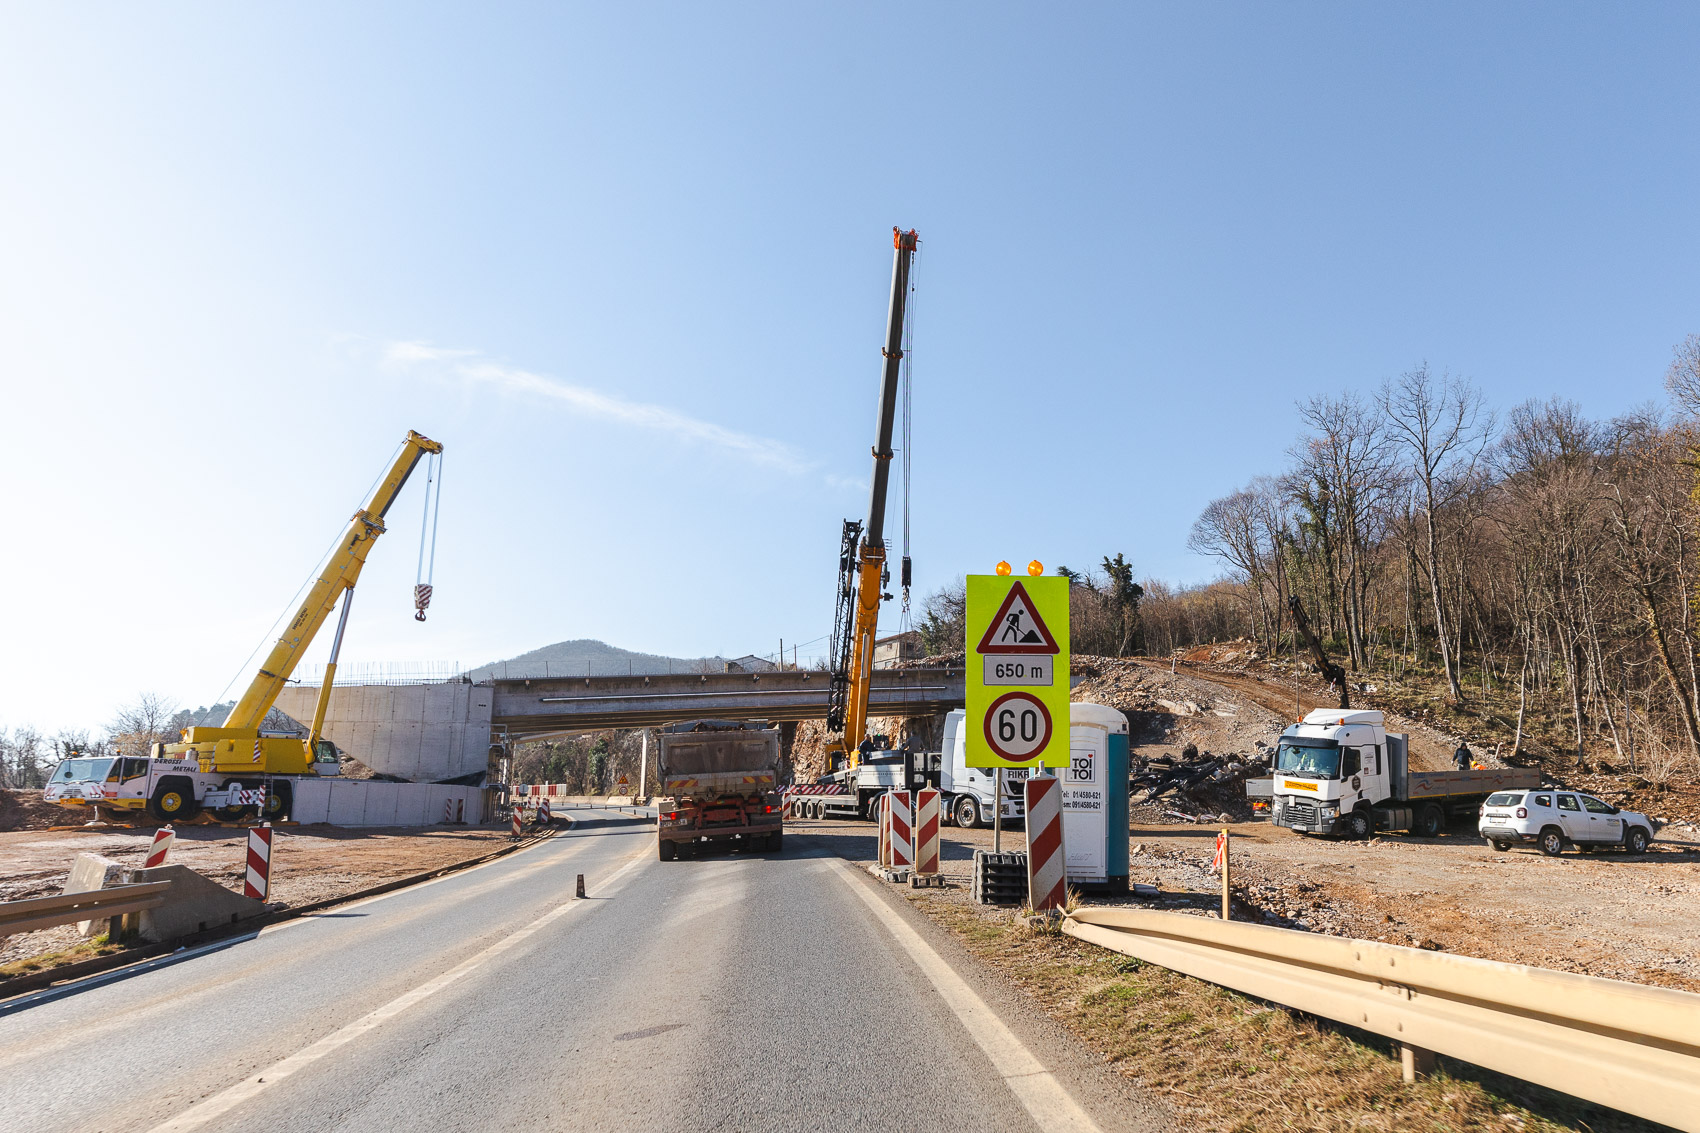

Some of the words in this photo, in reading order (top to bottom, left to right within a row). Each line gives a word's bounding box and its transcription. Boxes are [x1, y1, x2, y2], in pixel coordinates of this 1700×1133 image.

[995, 663, 1025, 679] 650
[1030, 666, 1043, 679] m
[998, 709, 1037, 742] 60
[1072, 758, 1092, 769] TOI
[1072, 769, 1092, 780] TOI
